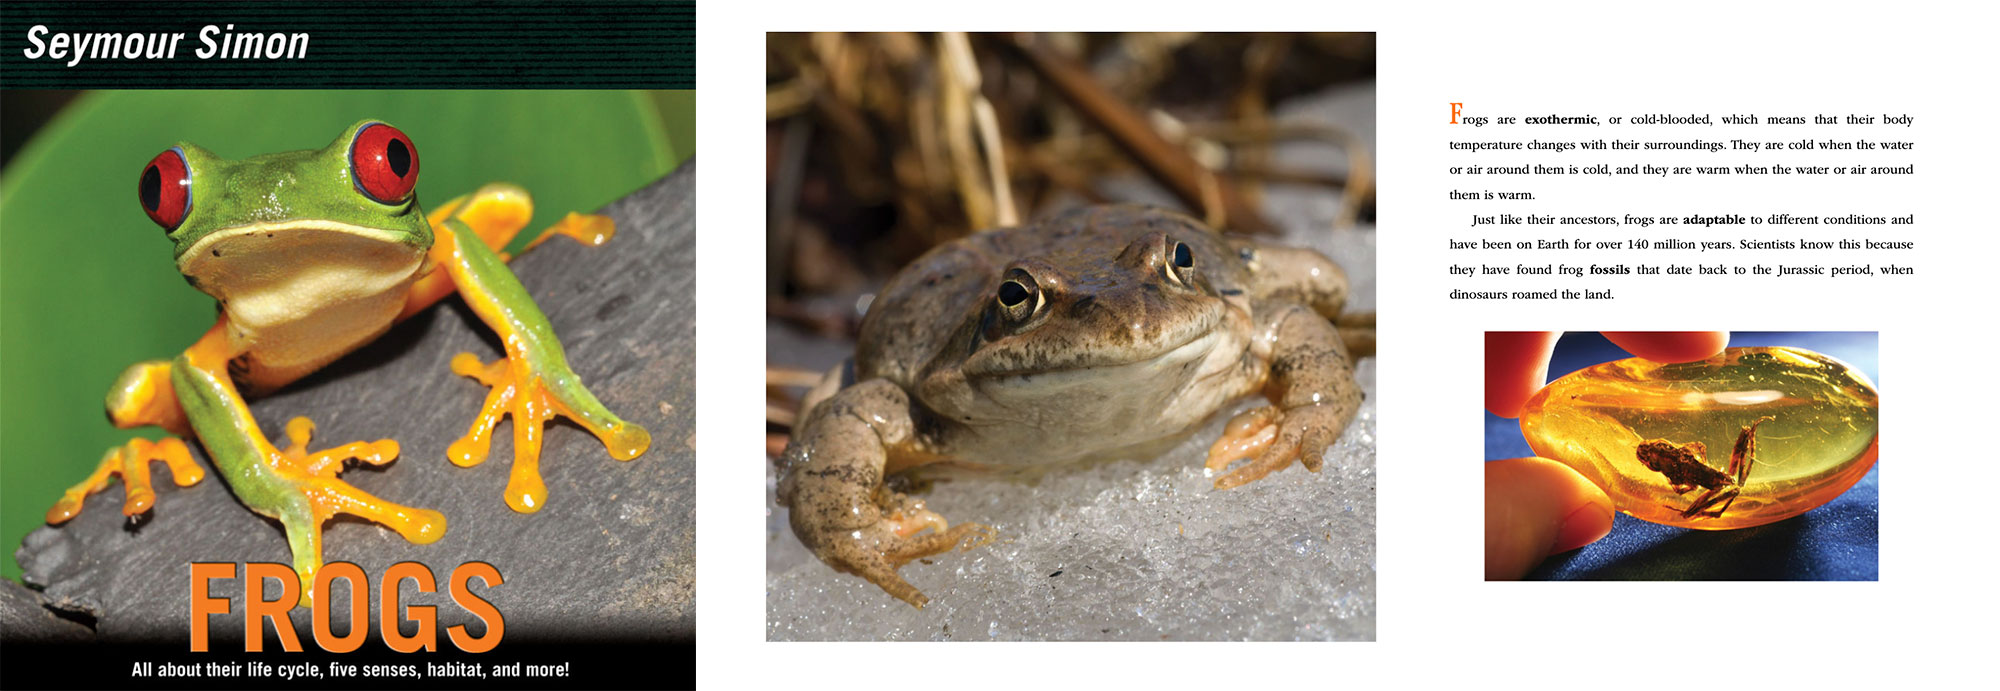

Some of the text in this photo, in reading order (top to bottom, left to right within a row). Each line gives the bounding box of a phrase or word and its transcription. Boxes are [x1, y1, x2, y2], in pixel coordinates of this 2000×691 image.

[24, 24, 308, 67] Seymour Simon
[1449, 102, 1914, 128] Frogs are exothermic, or cold-blooded, which means that their body
[1449, 139, 1915, 153] temperature changes with their surroundings. They are cold when the water
[1449, 163, 1914, 178] or air around them is cold, and they are warm when the water or air around
[1449, 189, 1536, 201] them is warm.
[1470, 213, 1914, 228] Just like their ancestors, frogs are adaptable to different conditions and
[1449, 238, 1914, 253] have been on Earth for over 140 million years. Scientists know this because
[1449, 263, 1914, 278] they have found frog fossils that date back to the Jurassic period, when
[1449, 288, 1615, 300] dinosaurs roamed the land.
[191, 561, 504, 652] FROGS
[131, 661, 569, 681] All about their life cycle, five senses, habitat, and more!
